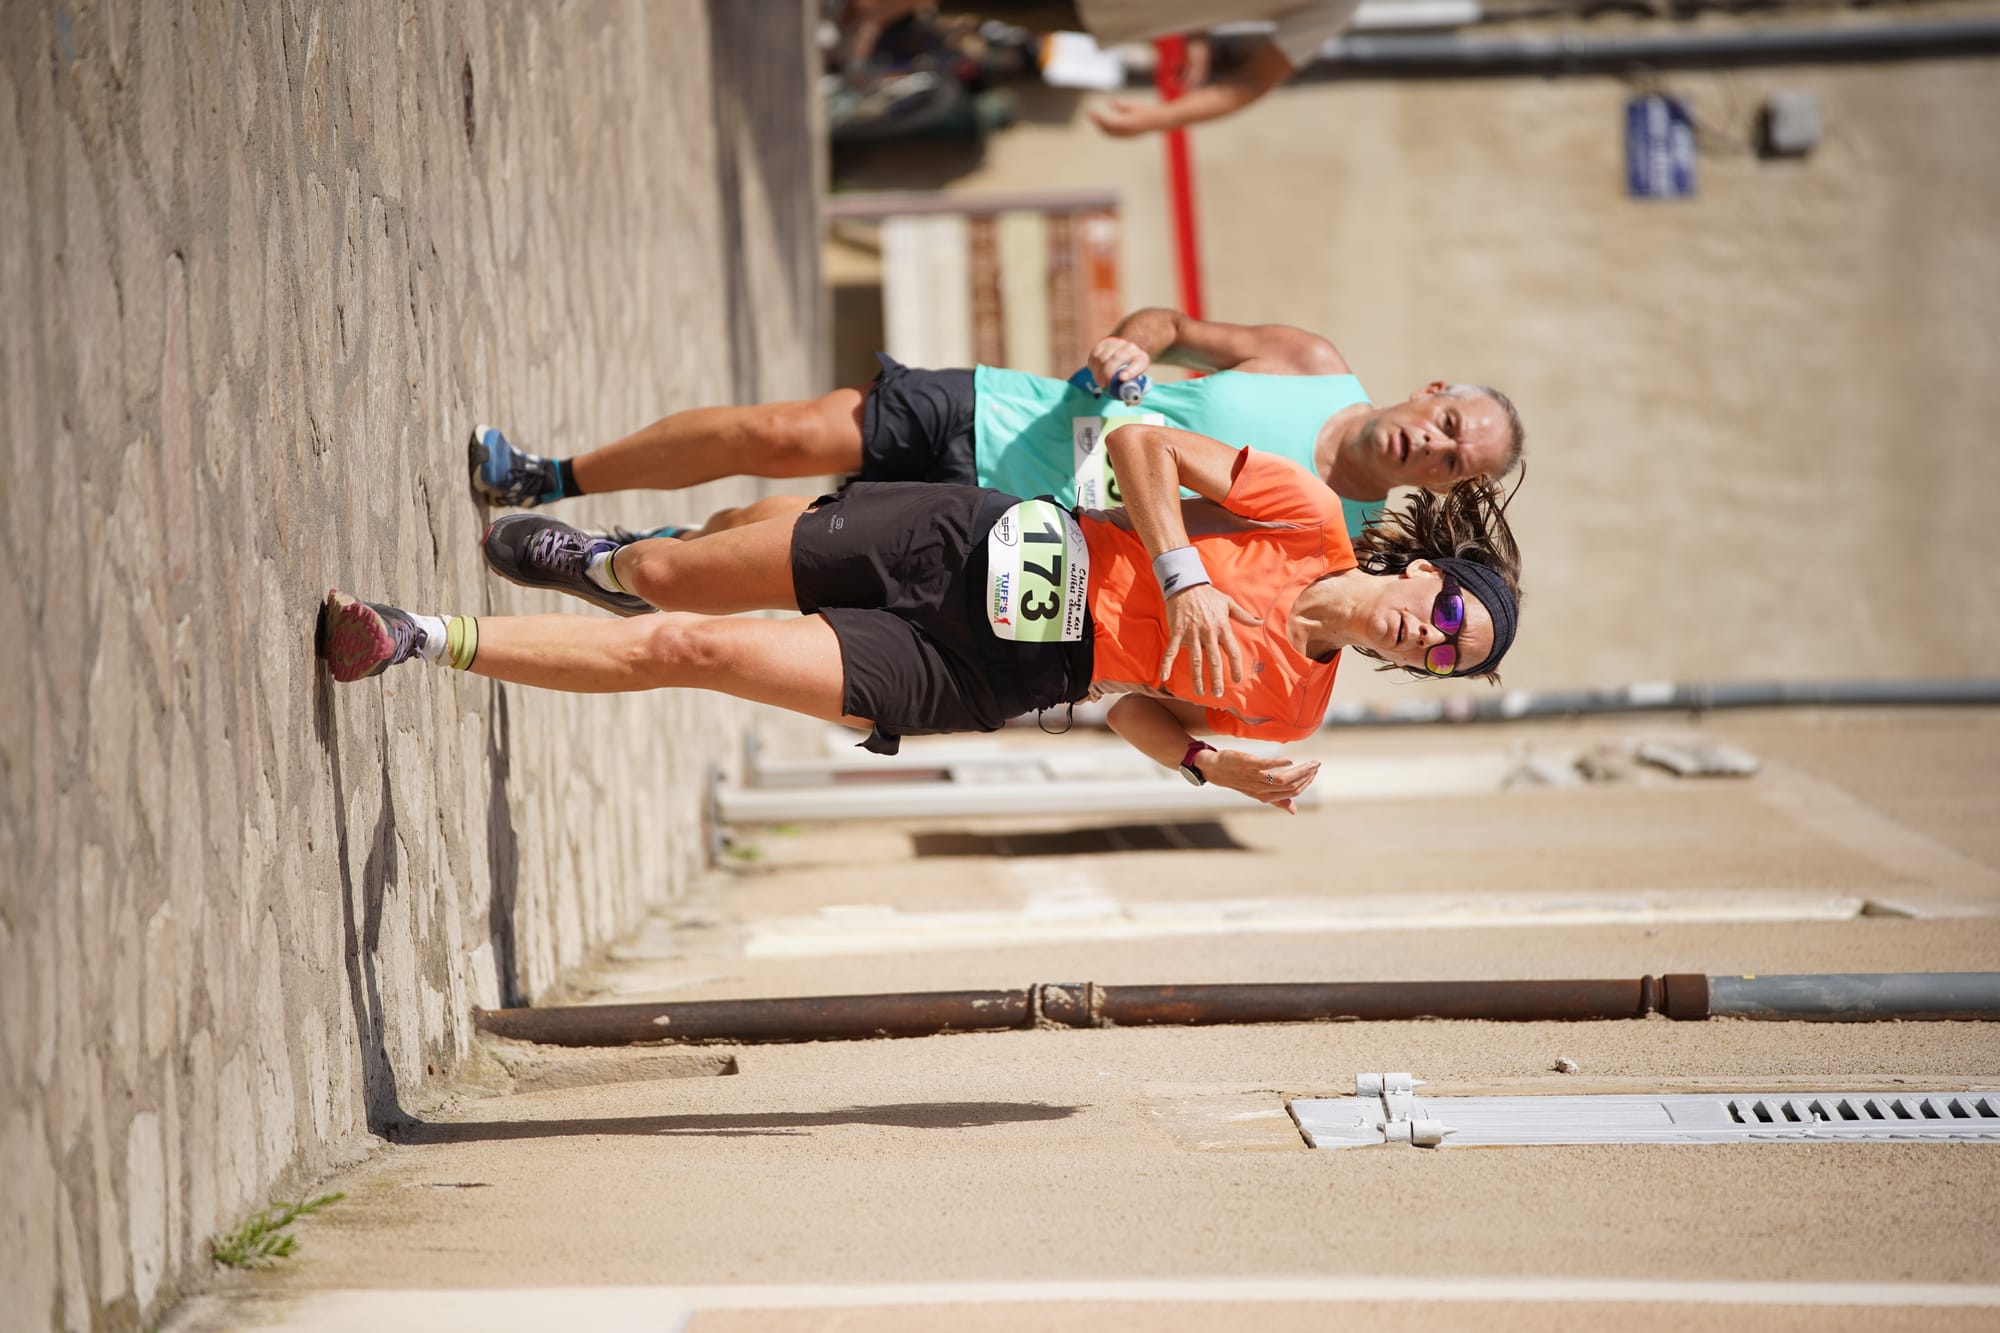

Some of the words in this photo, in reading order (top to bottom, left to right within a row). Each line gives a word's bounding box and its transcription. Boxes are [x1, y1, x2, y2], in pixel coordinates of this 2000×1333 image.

[1001, 516, 1010, 542] BFP
[999, 572, 1010, 613] TUFF'S
[1020, 522, 1062, 622] 173
[1069, 563, 1077, 593] vallées
[1075, 568, 1086, 612] Challenge
[994, 576, 1003, 617] Aventure
